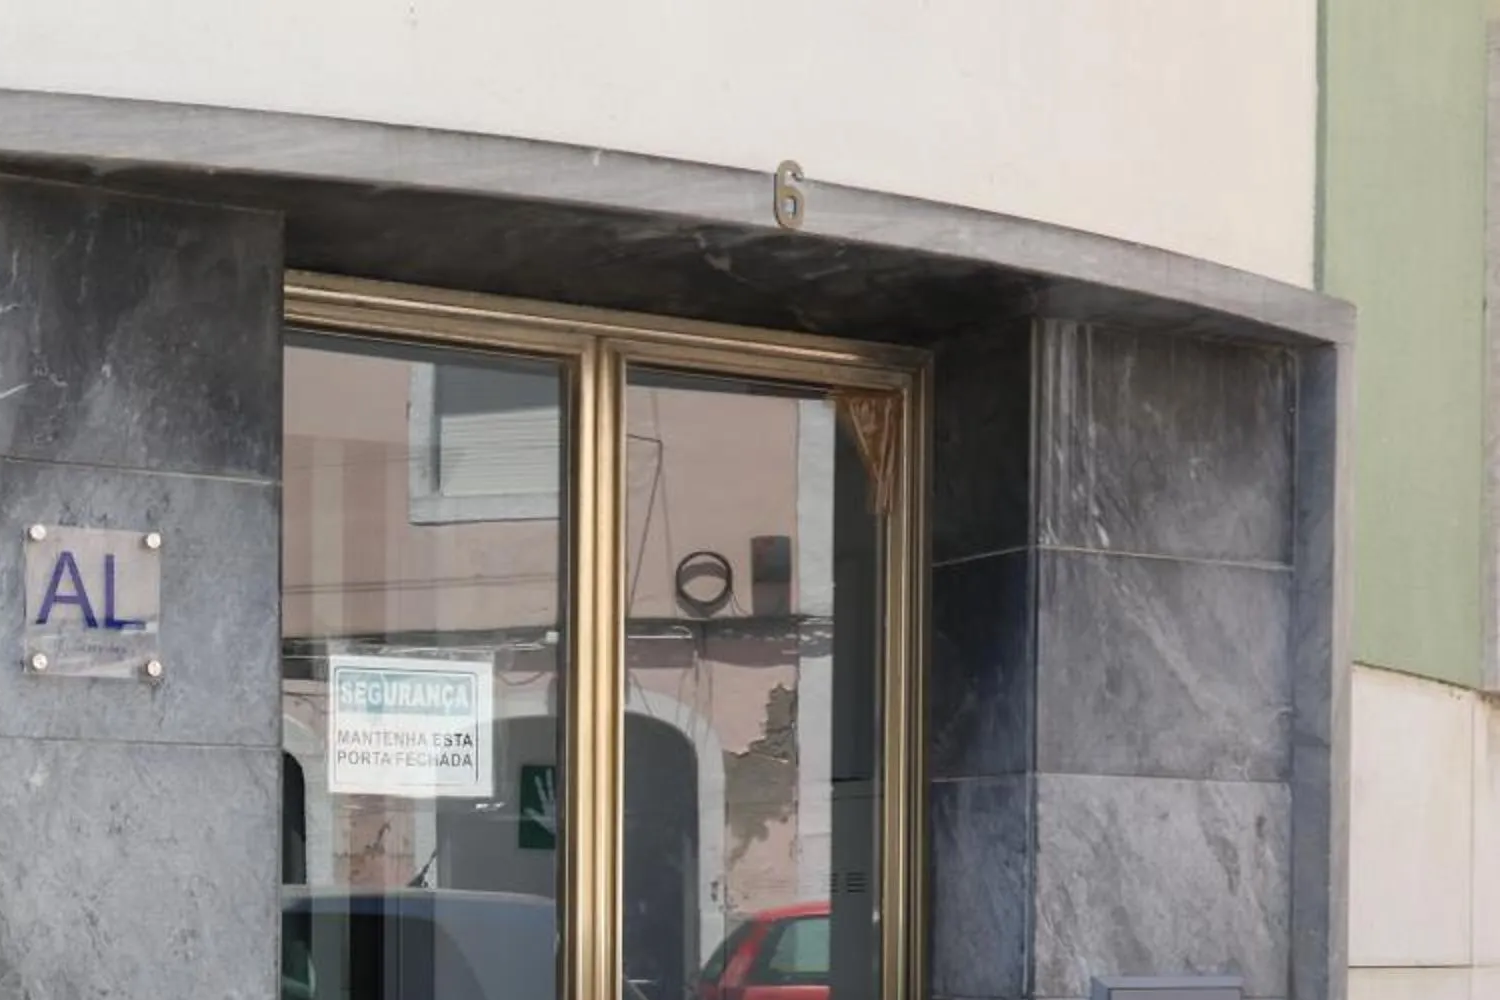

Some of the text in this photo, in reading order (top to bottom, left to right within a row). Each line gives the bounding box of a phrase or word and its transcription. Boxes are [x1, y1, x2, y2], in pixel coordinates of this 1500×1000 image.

[773, 159, 805, 229] 6
[35, 551, 147, 629] AL
[339, 678, 469, 712] SEGURANÇA
[338, 729, 473, 748] MANTENHA ESTA
[338, 750, 473, 768] PORTA FECHADA
